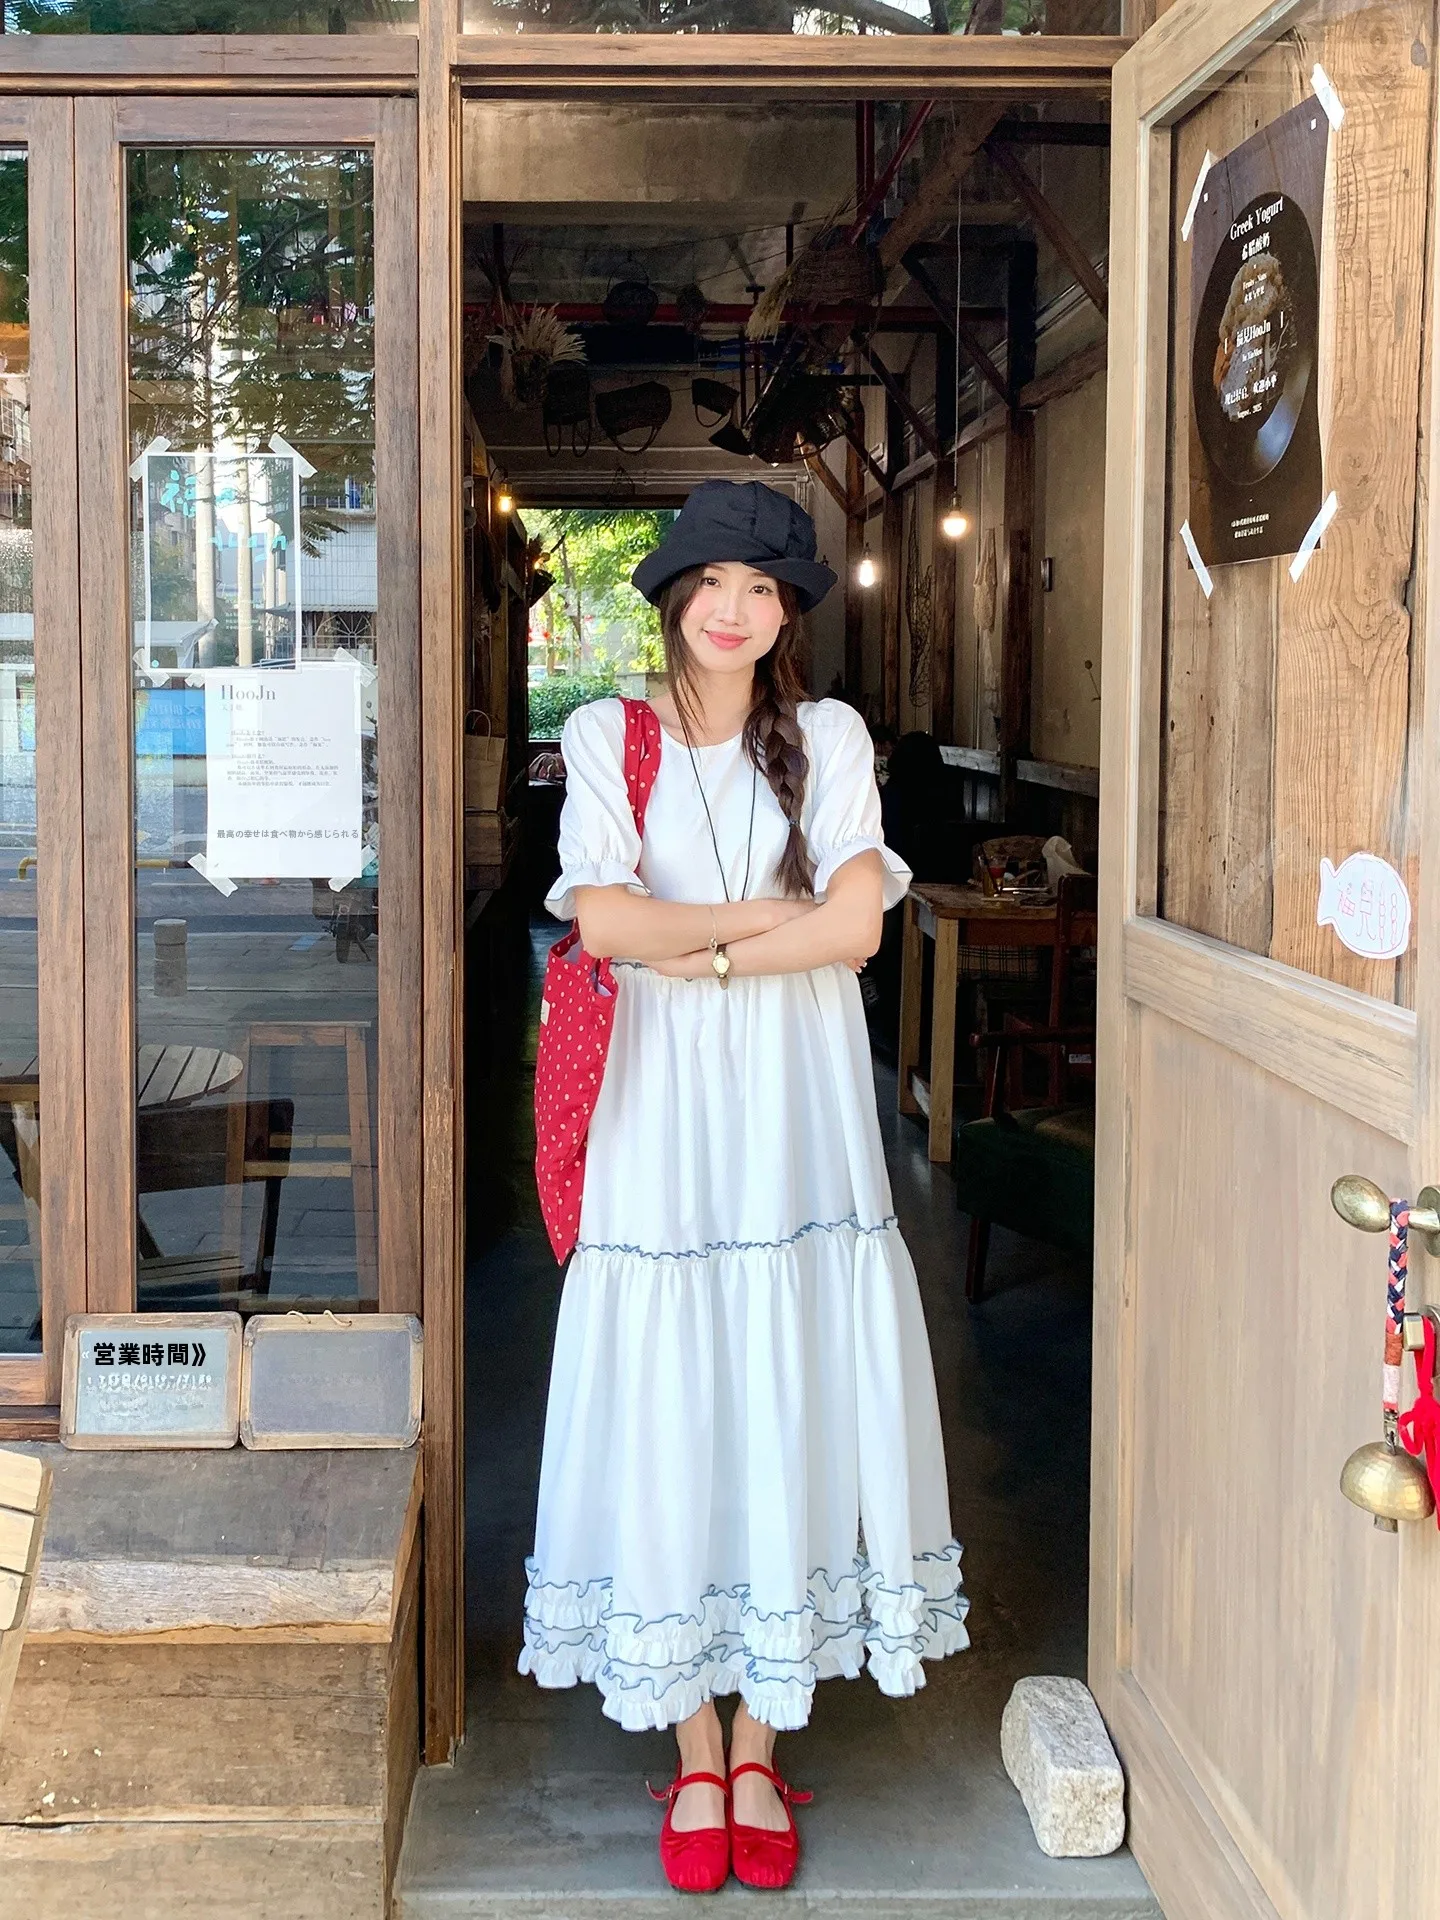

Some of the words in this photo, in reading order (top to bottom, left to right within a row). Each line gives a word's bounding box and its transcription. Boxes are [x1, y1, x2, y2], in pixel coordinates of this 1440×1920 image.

[1230, 214, 1253, 241] Greek
[1255, 196, 1283, 226] Yogurt
[216, 829, 359, 839] 最高の幸せは食べ物から感じられる
